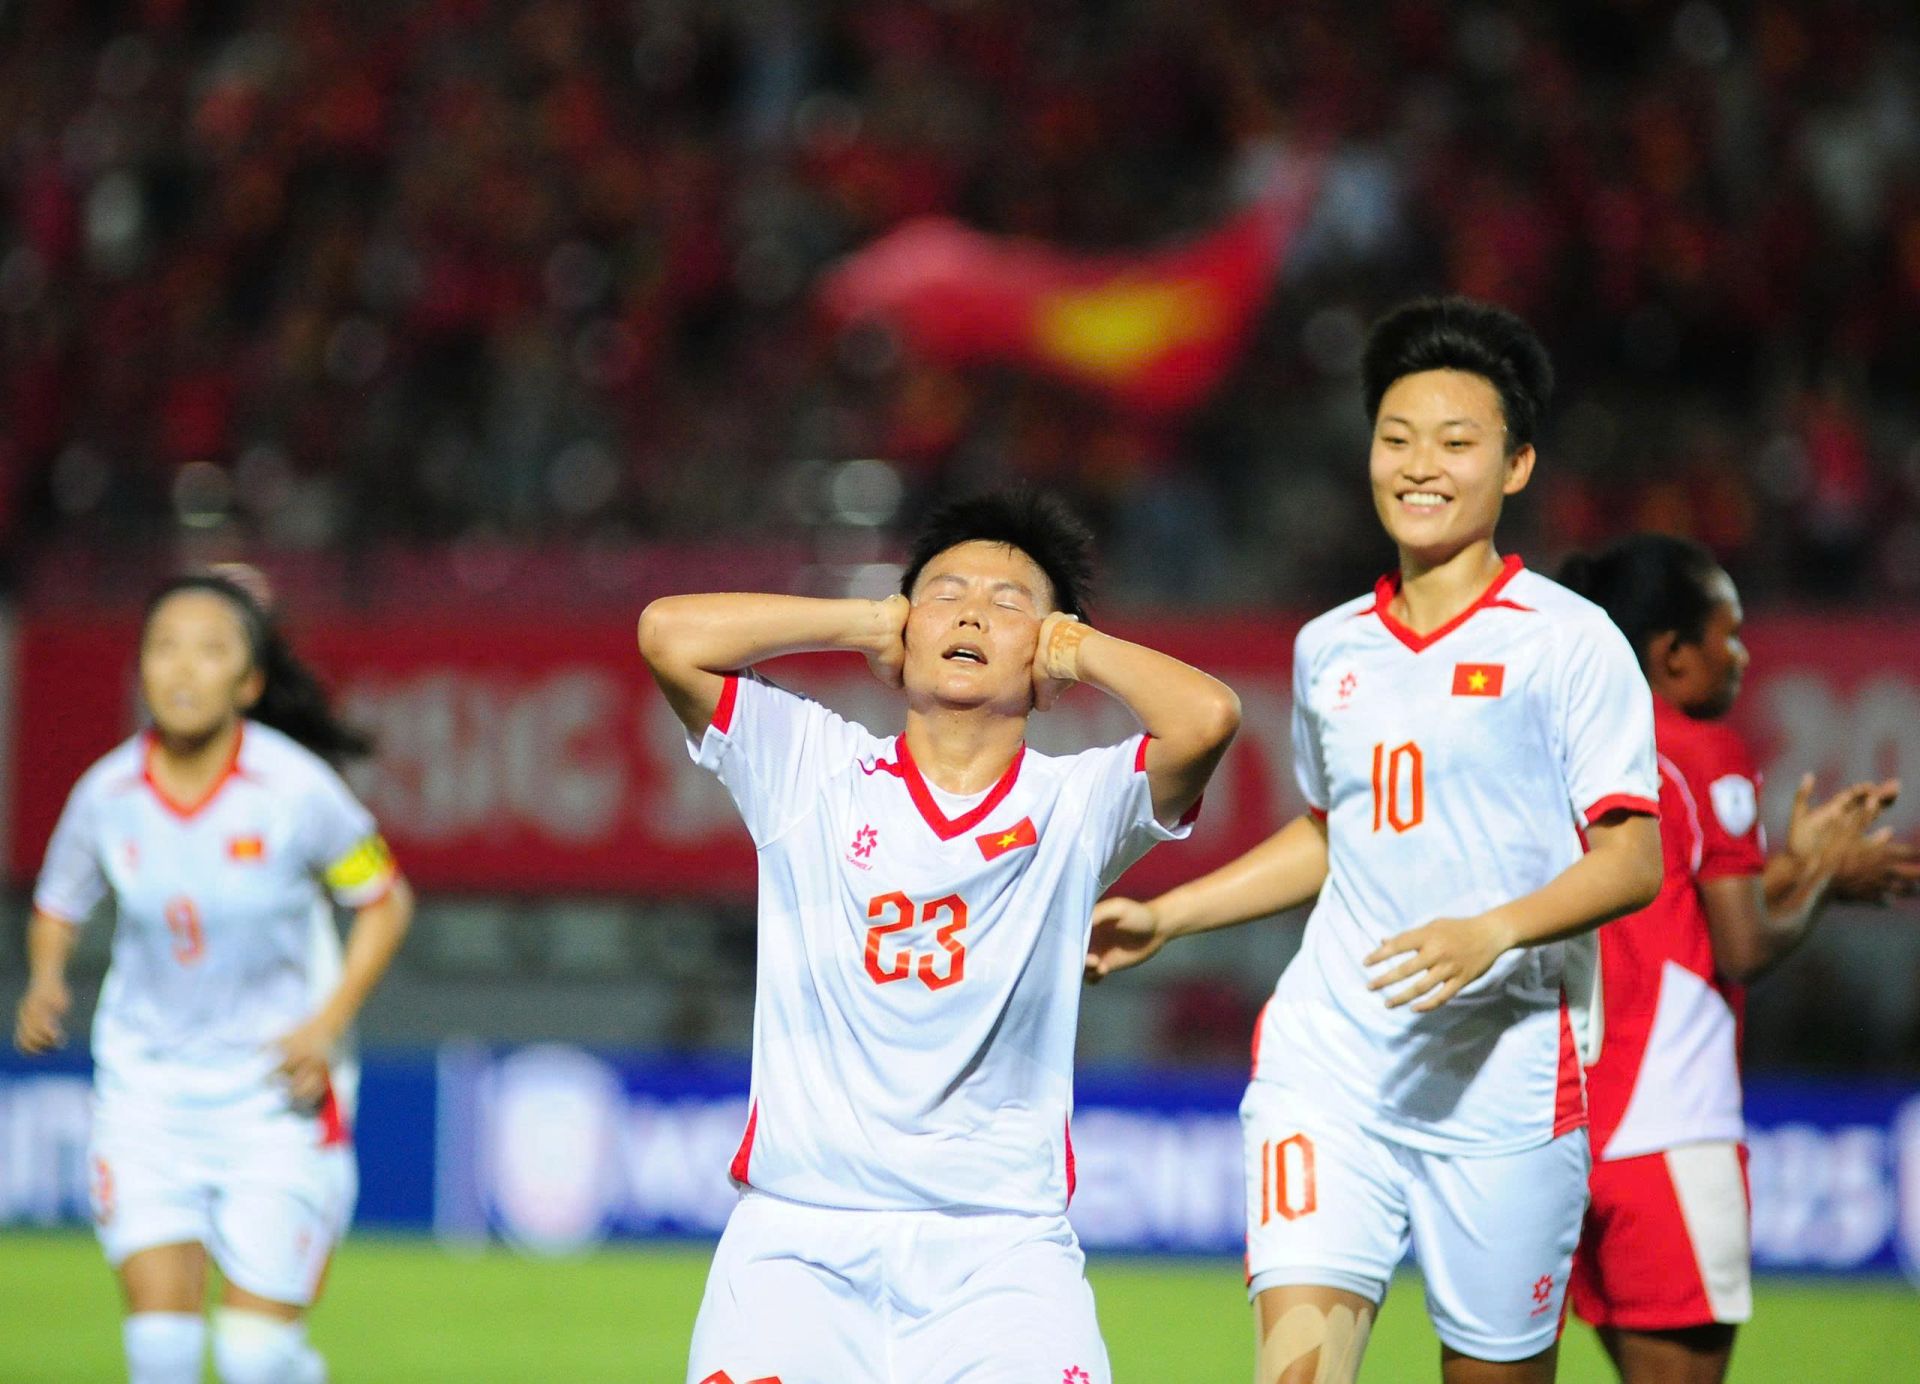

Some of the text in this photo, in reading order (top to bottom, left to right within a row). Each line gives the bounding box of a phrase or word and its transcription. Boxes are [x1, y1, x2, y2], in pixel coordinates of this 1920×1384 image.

[1372, 740, 1423, 832] 10
[163, 897, 205, 969] 9
[864, 890, 968, 991] 23
[1261, 1133, 1317, 1225] 10
